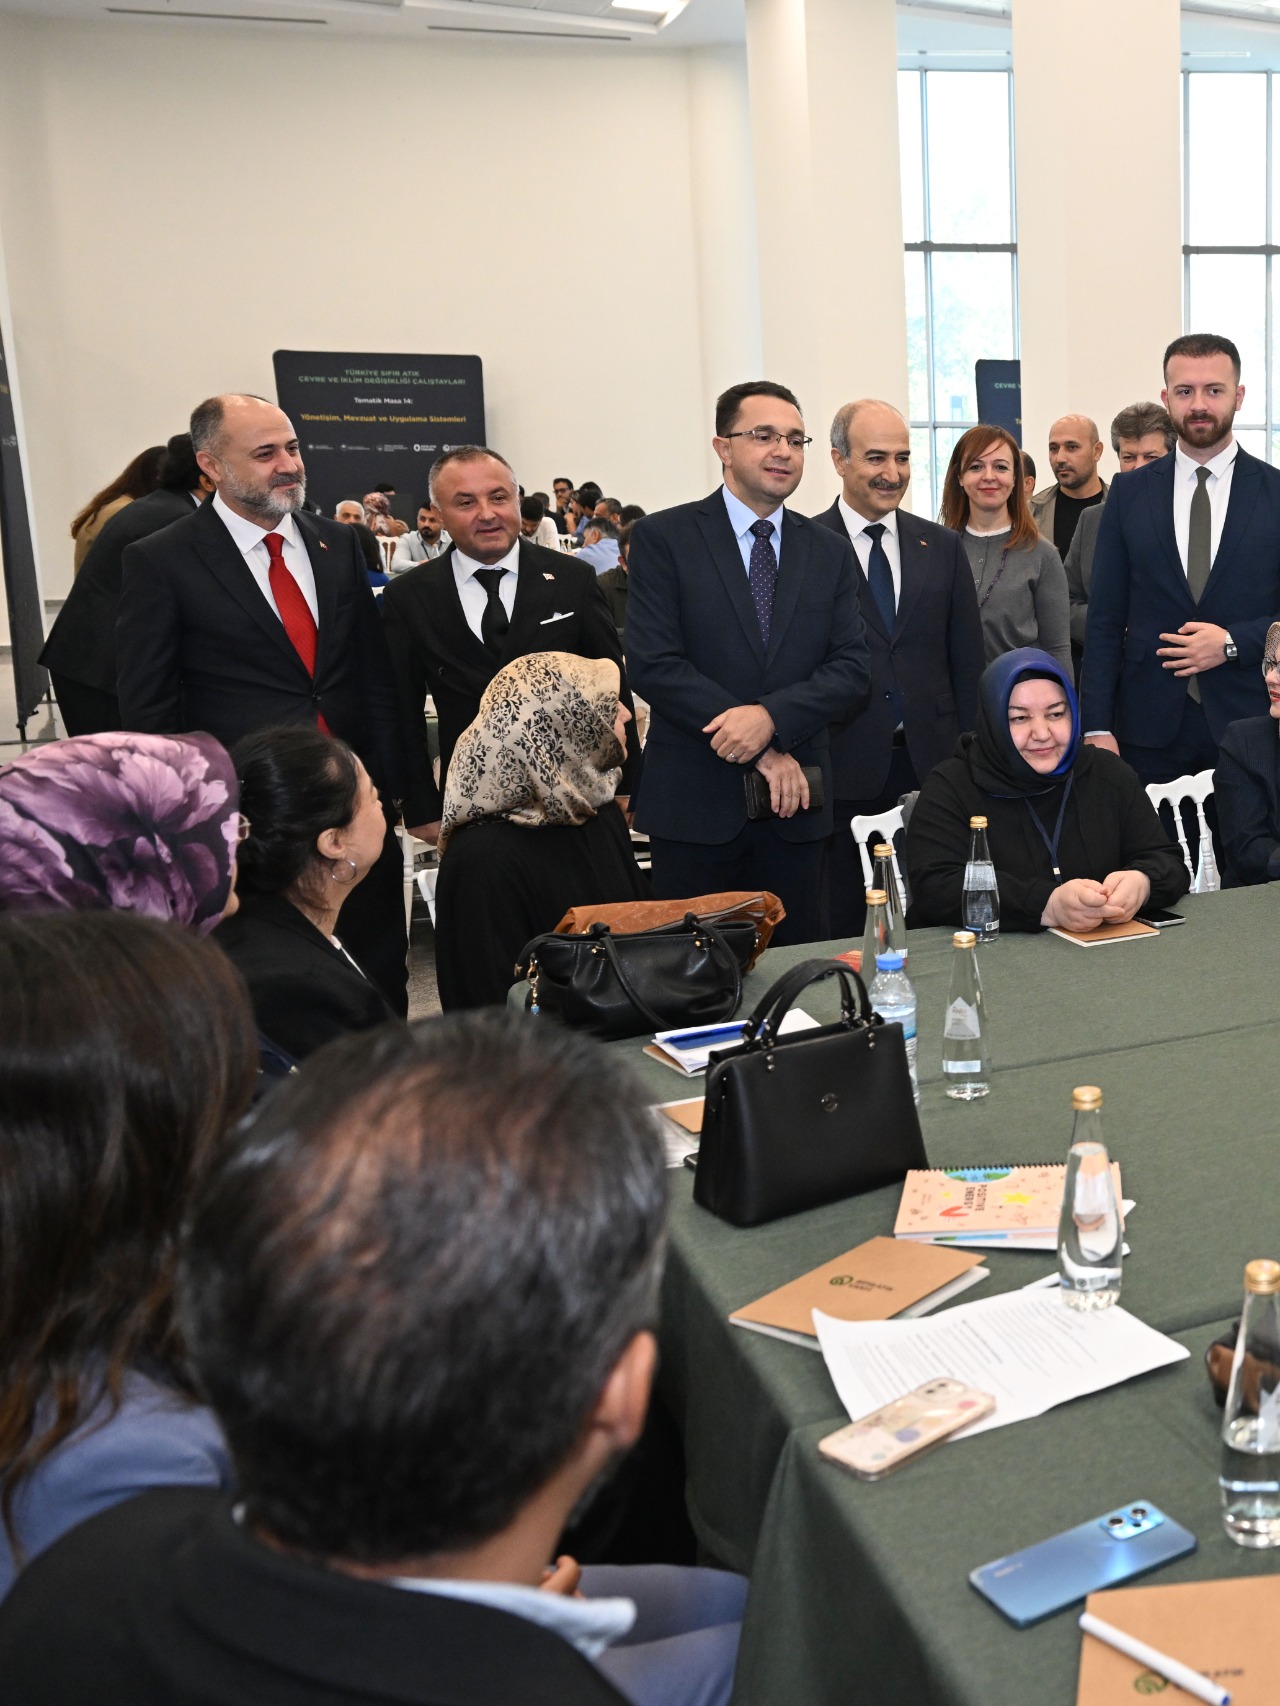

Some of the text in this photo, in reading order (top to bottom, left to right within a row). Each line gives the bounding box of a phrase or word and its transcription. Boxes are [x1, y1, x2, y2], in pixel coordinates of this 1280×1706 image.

[354, 396, 382, 404] Tematik
[344, 414, 377, 422] Mevzuat
[389, 415, 427, 424] Uygulama
[429, 415, 467, 423] Sistemleri
